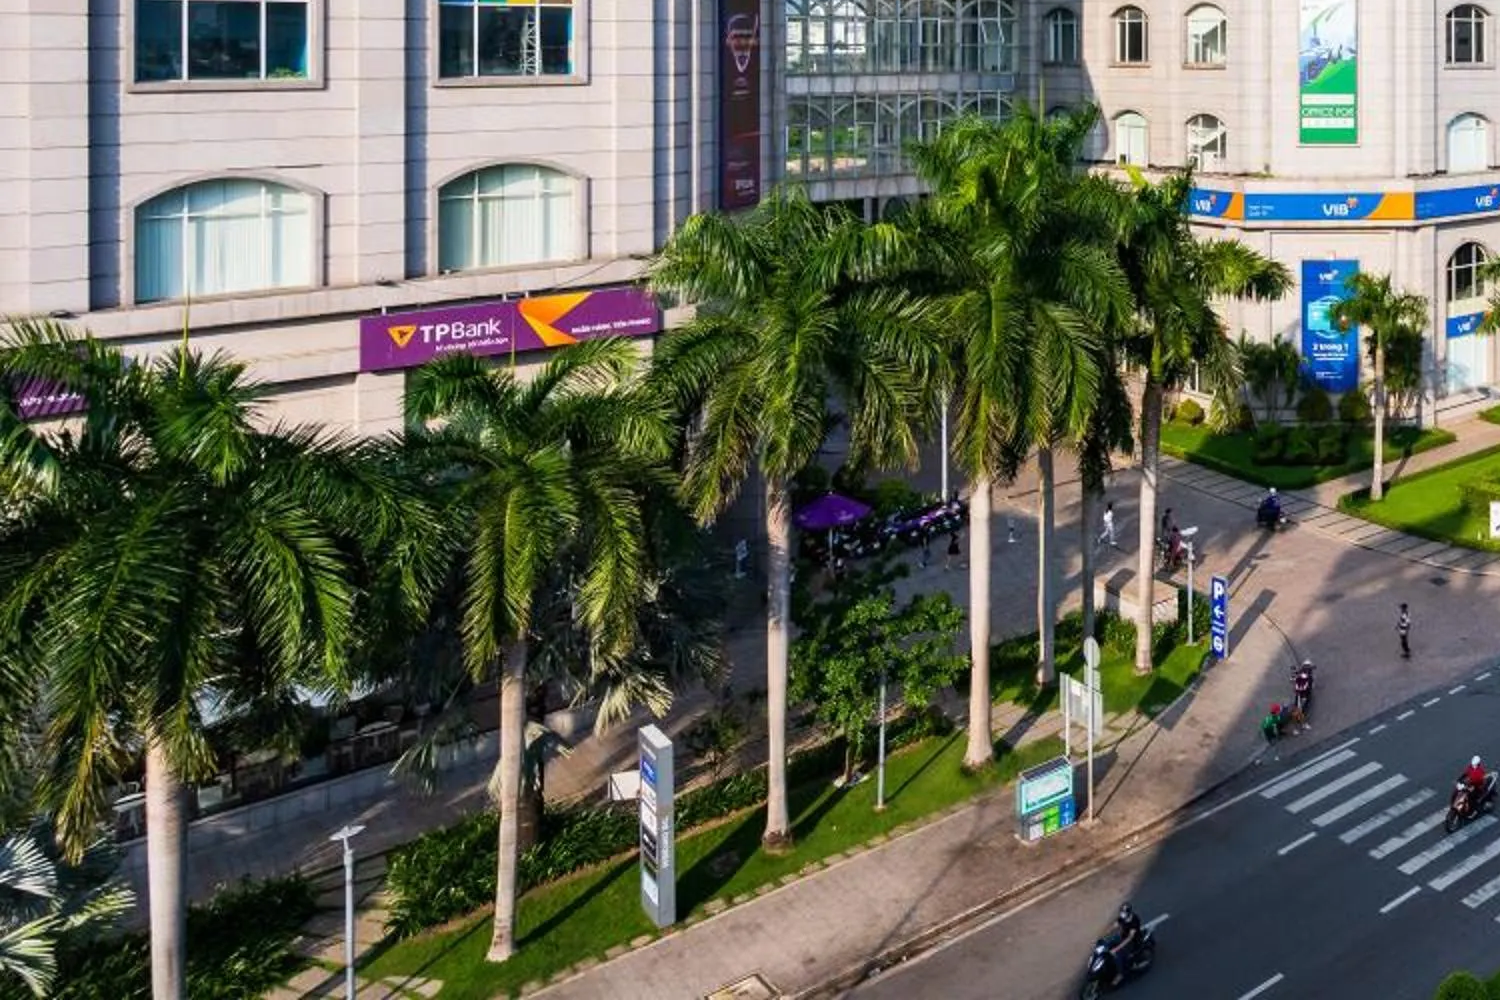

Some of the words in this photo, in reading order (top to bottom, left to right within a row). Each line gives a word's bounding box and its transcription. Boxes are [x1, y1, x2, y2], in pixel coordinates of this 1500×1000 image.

[1322, 203, 1349, 217] VIB
[1475, 195, 1494, 208] VIB
[420, 317, 502, 344] TPBank
[1213, 580, 1225, 600] P
